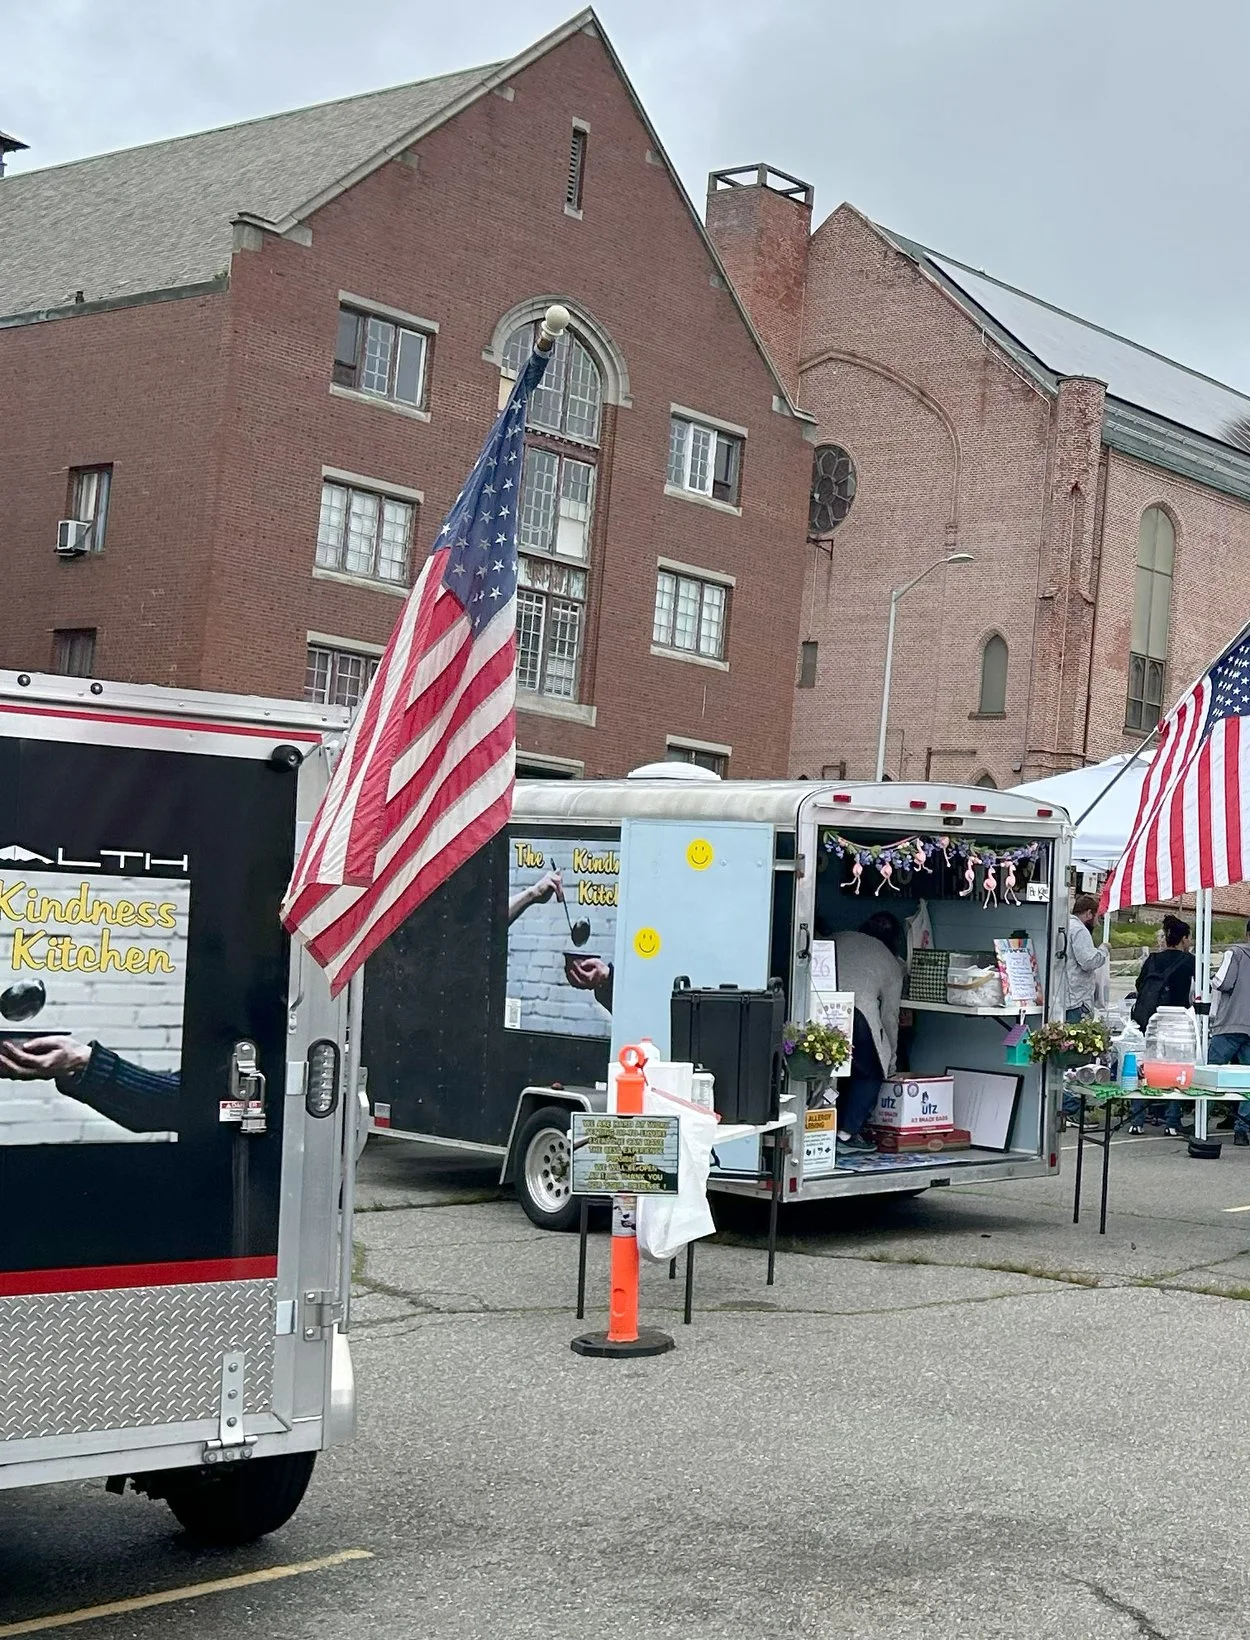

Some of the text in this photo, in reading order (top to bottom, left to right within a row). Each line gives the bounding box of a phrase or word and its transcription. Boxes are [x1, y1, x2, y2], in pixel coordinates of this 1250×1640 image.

[515, 843, 545, 868] The
[0, 879, 178, 928] Kindness
[11, 927, 176, 974] Kitchen
[881, 1096, 896, 1109] utz
[921, 1103, 938, 1115] utz
[647, 1173, 664, 1181] YOU
